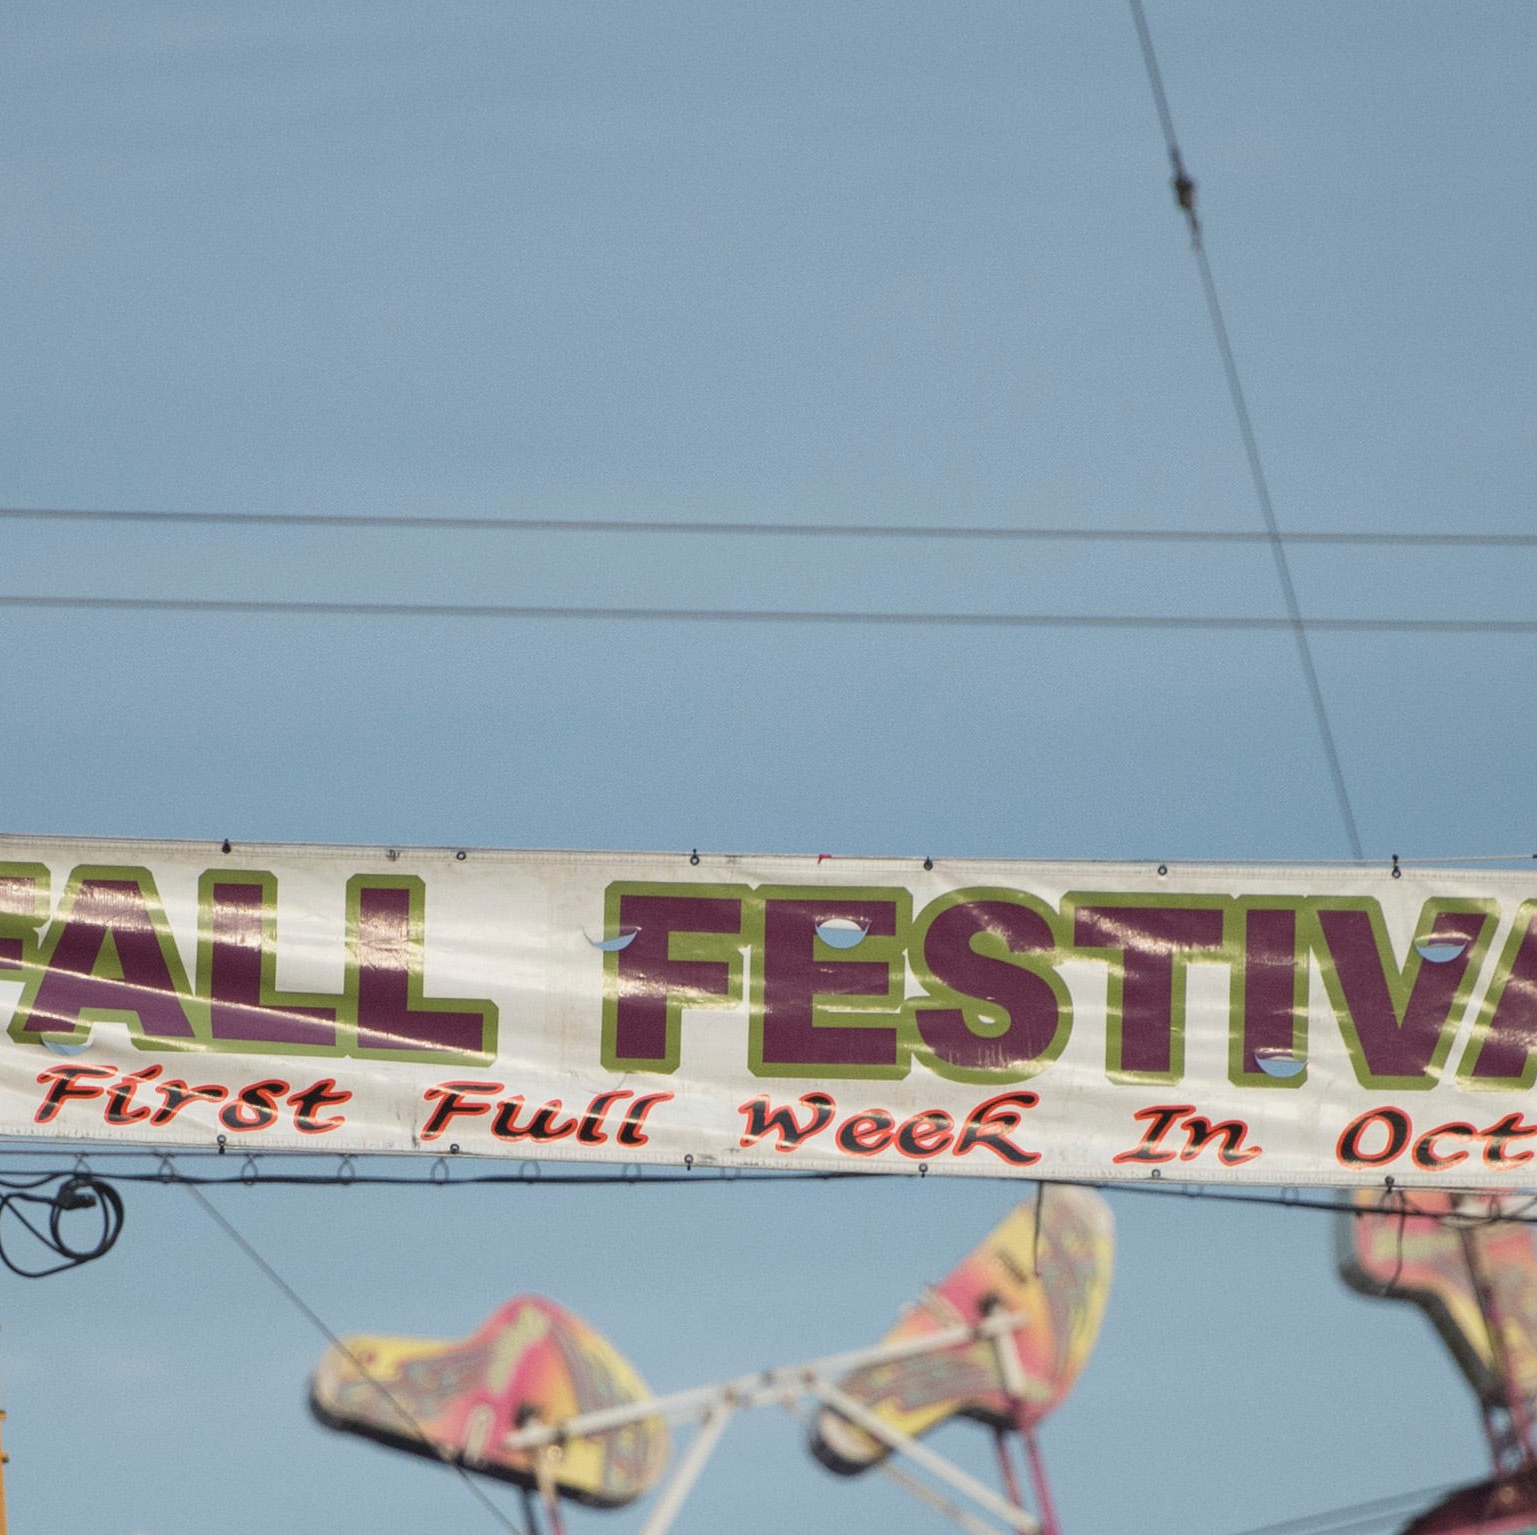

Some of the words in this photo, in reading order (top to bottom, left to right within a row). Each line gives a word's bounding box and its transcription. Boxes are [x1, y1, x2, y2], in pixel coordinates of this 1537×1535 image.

[34, 1064, 352, 1134] First
[420, 1081, 674, 1146] Full
[738, 1091, 1042, 1166] Week
[1112, 1104, 1263, 1167] In
